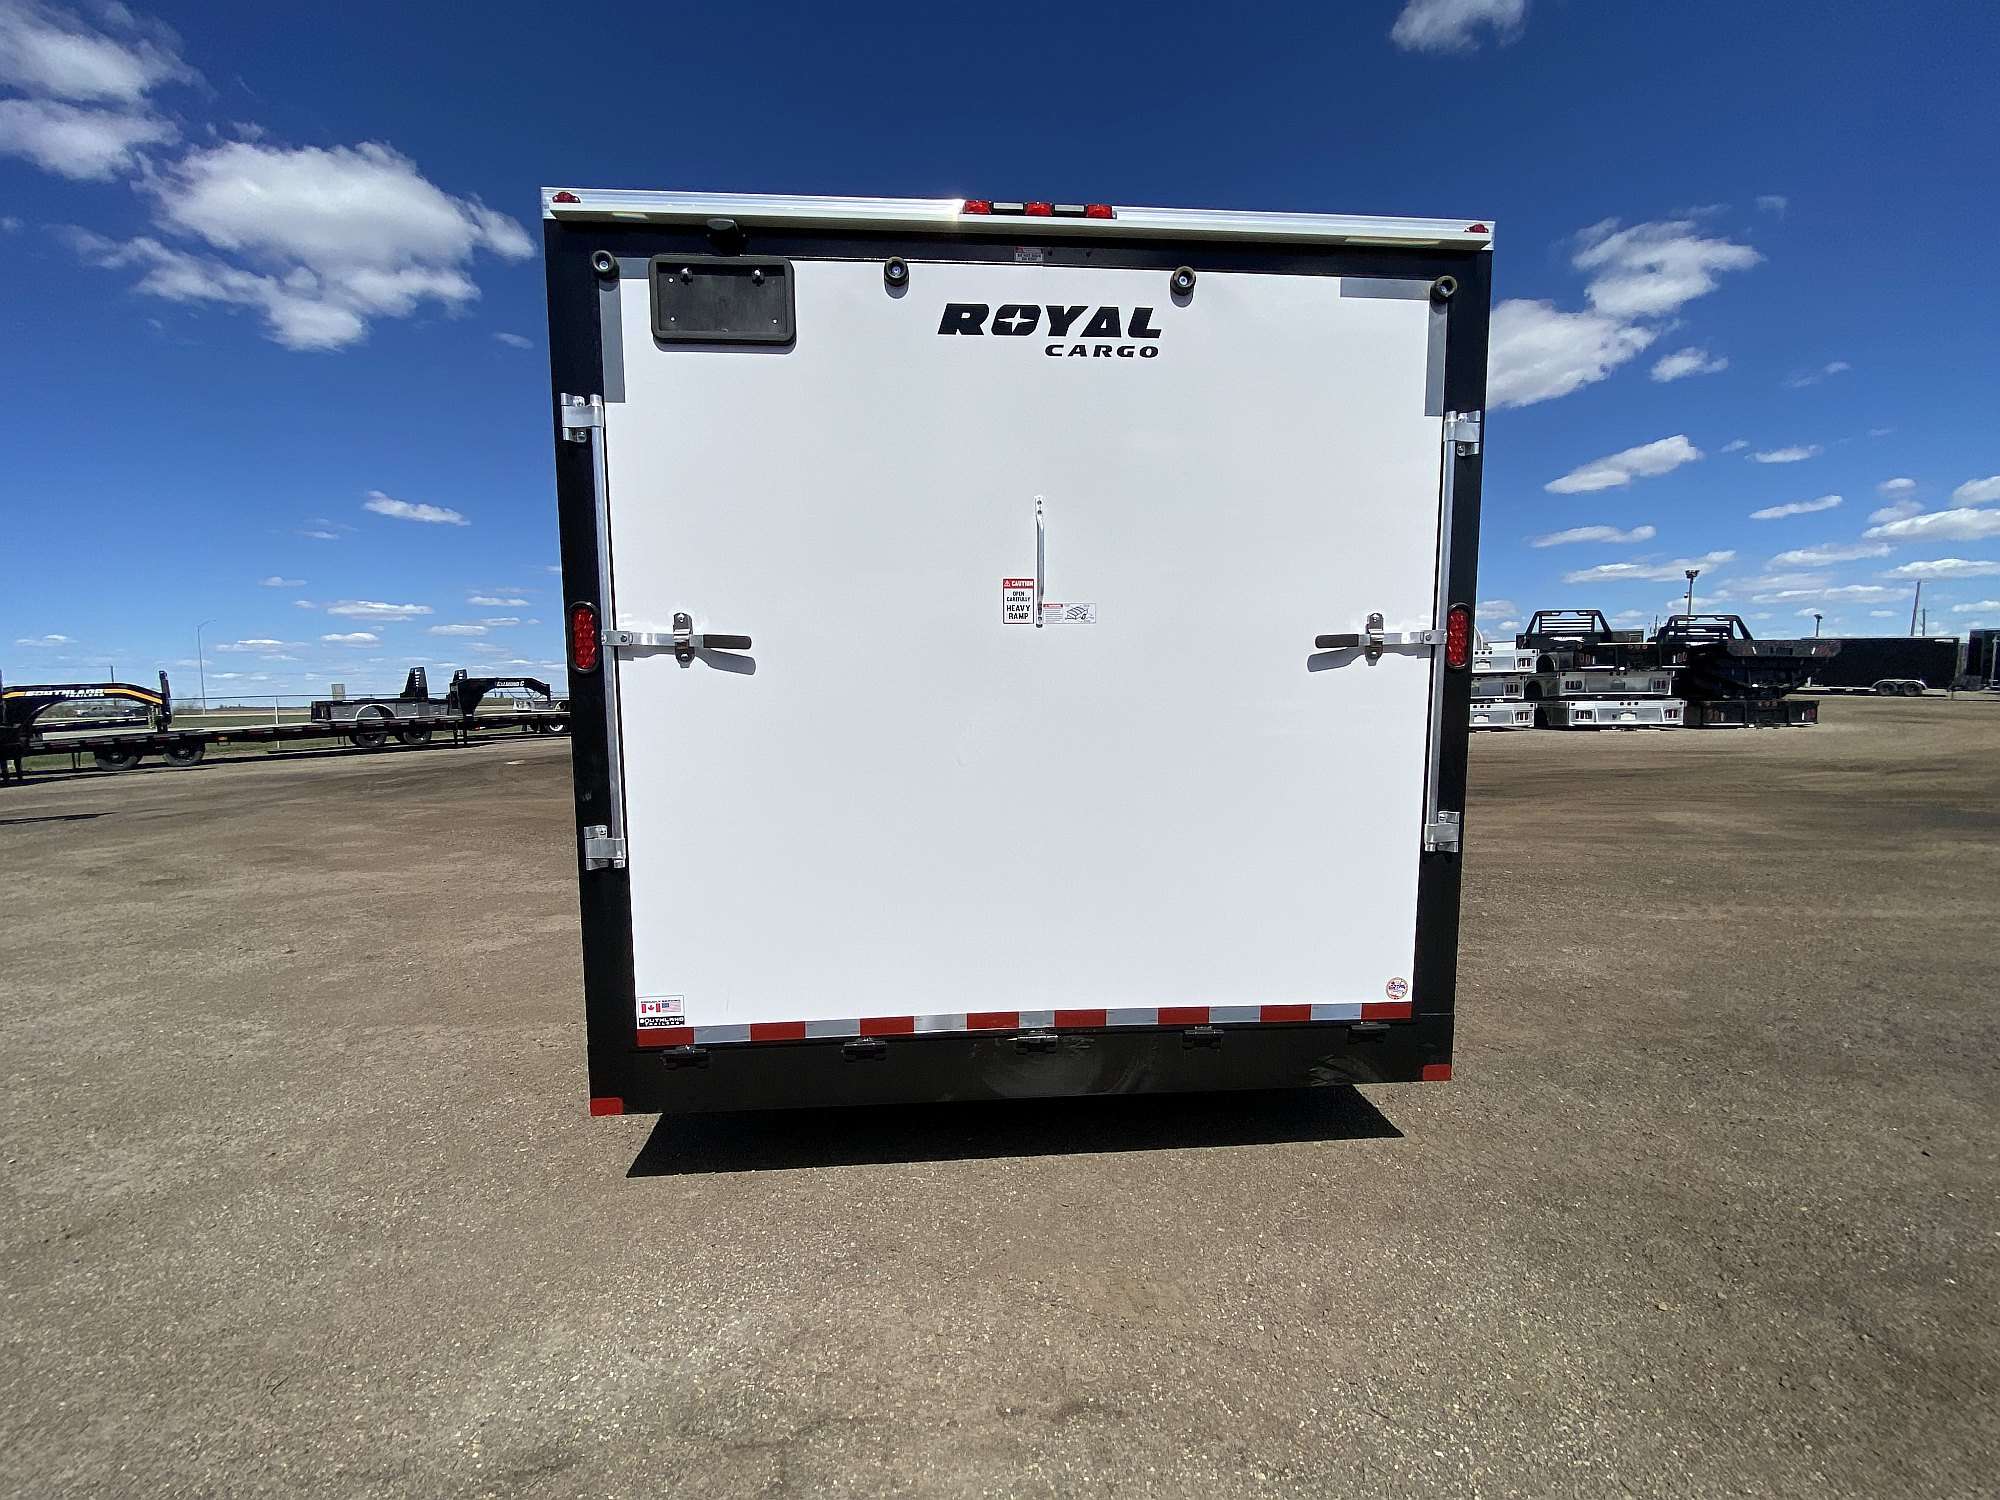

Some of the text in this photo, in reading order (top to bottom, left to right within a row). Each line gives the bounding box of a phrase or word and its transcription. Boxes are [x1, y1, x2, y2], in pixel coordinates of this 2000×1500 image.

[937, 303, 1162, 339] ROYAL
[1045, 344, 1159, 359] CARGO
[1006, 604, 1031, 612] HEAVY
[1008, 612, 1029, 620] RAMP
